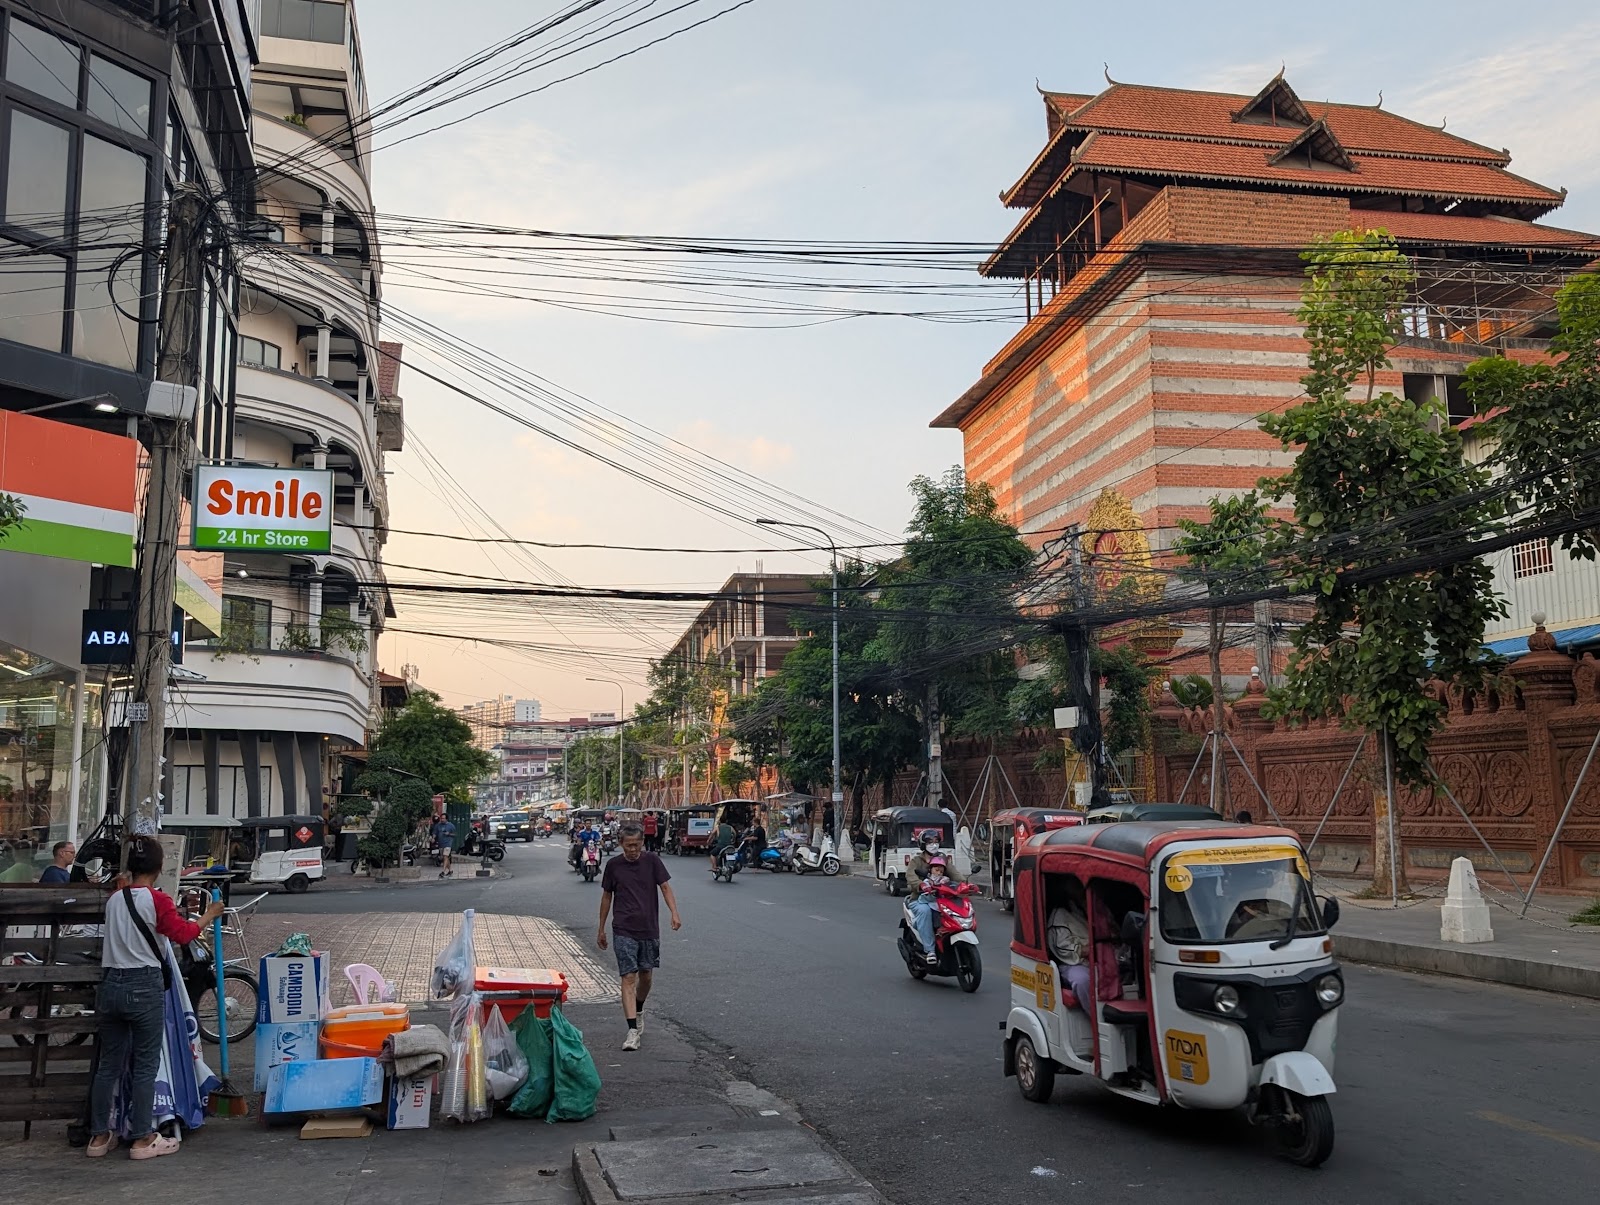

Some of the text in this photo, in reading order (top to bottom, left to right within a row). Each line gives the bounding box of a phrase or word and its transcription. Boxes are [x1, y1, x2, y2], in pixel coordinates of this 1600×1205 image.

[207, 479, 322, 519] Smile
[217, 530, 309, 547] 24 hr Store
[1167, 874, 1190, 883] TADA
[287, 963, 304, 1016] CAMBODIA
[1167, 1036, 1204, 1057] TADA
